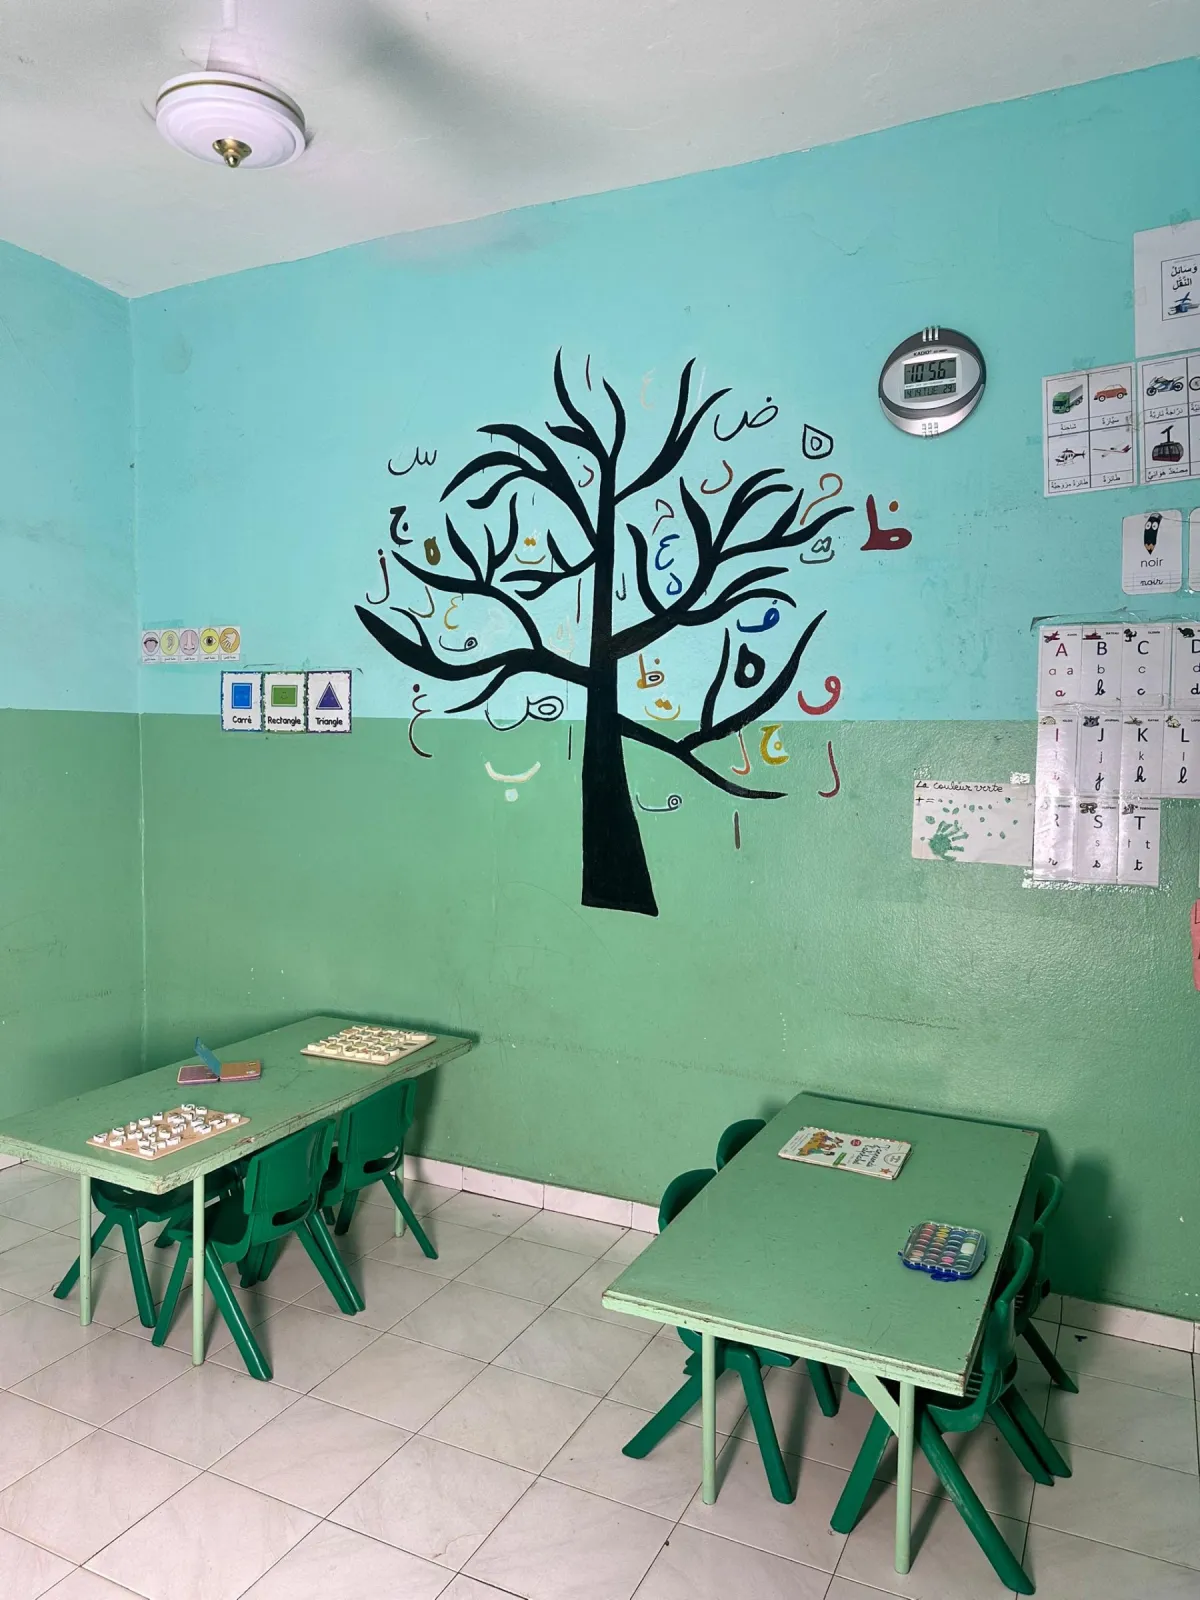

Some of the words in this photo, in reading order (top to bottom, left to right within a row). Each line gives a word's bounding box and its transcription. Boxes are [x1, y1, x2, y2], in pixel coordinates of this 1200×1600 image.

[713, 395, 779, 442] ض
[387, 446, 437, 476] س
[389, 505, 414, 546] ج
[860, 493, 913, 552] ظ
[655, 533, 681, 571] ع
[1140, 557, 1164, 568] noir
[1140, 578, 1164, 587] noir
[736, 599, 780, 634] ف
[1055, 642, 1068, 657] A
[1097, 641, 1108, 656] B
[1137, 640, 1150, 655] C
[1048, 668, 1057, 676] a
[1066, 667, 1074, 676] a
[1097, 664, 1106, 675] b
[1138, 665, 1146, 674] c
[1055, 689, 1066, 697] a
[1094, 678, 1106, 696] b
[1136, 687, 1146, 696] c
[1190, 682, 1200, 695] d
[231, 714, 253, 724] Carré
[267, 715, 302, 727] Rectangle
[315, 716, 344, 728] Triangle
[1097, 727, 1104, 742] J
[1137, 727, 1149, 743] K
[1181, 727, 1190, 743] L
[759, 723, 790, 766] ج
[1098, 751, 1103, 764] j
[1138, 750, 1145, 761] k
[482, 760, 542, 803] ب
[1095, 772, 1105, 791] j
[1134, 765, 1147, 783] k
[1177, 766, 1188, 784] l
[915, 780, 929, 789] La
[933, 781, 973, 792] couleur
[1093, 814, 1104, 829] S
[1133, 815, 1146, 830] T
[1095, 839, 1100, 847] s
[1145, 840, 1151, 850] t
[1133, 859, 1144, 871] t
